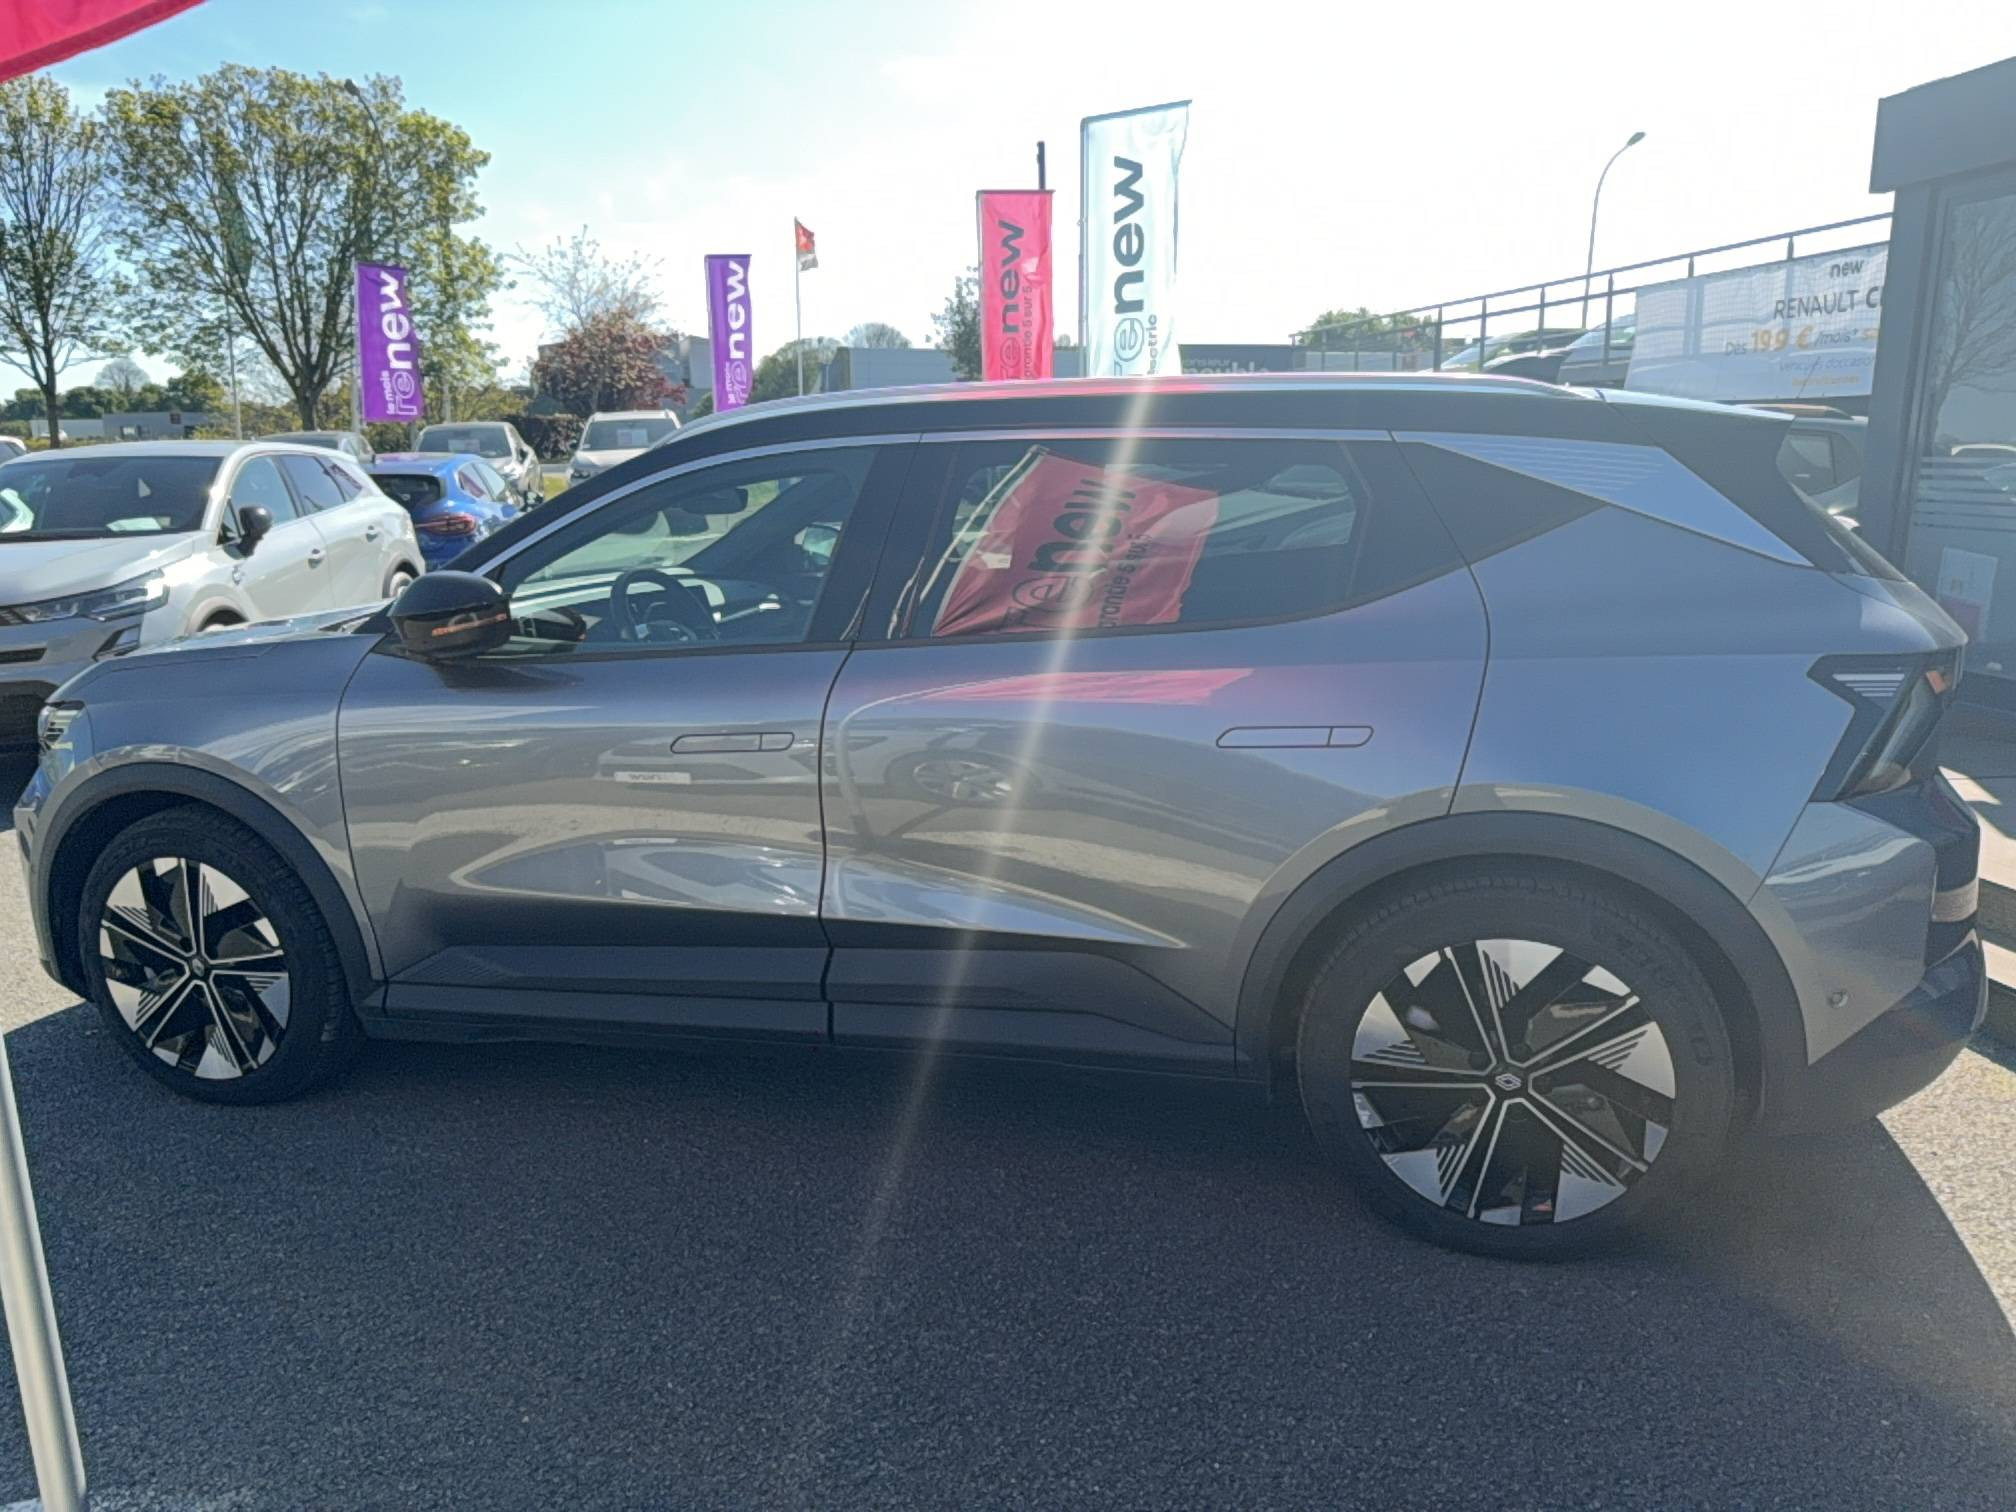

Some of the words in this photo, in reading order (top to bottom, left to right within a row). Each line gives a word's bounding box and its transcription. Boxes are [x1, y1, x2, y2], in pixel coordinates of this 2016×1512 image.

[1829, 258, 1864, 280] new
[998, 219, 1025, 379] renew
[1773, 290, 1858, 320] RENAULT
[1865, 286, 1882, 308] C
[380, 270, 418, 416] renew
[1752, 328, 1789, 353] 199
[1796, 325, 1813, 349] €
